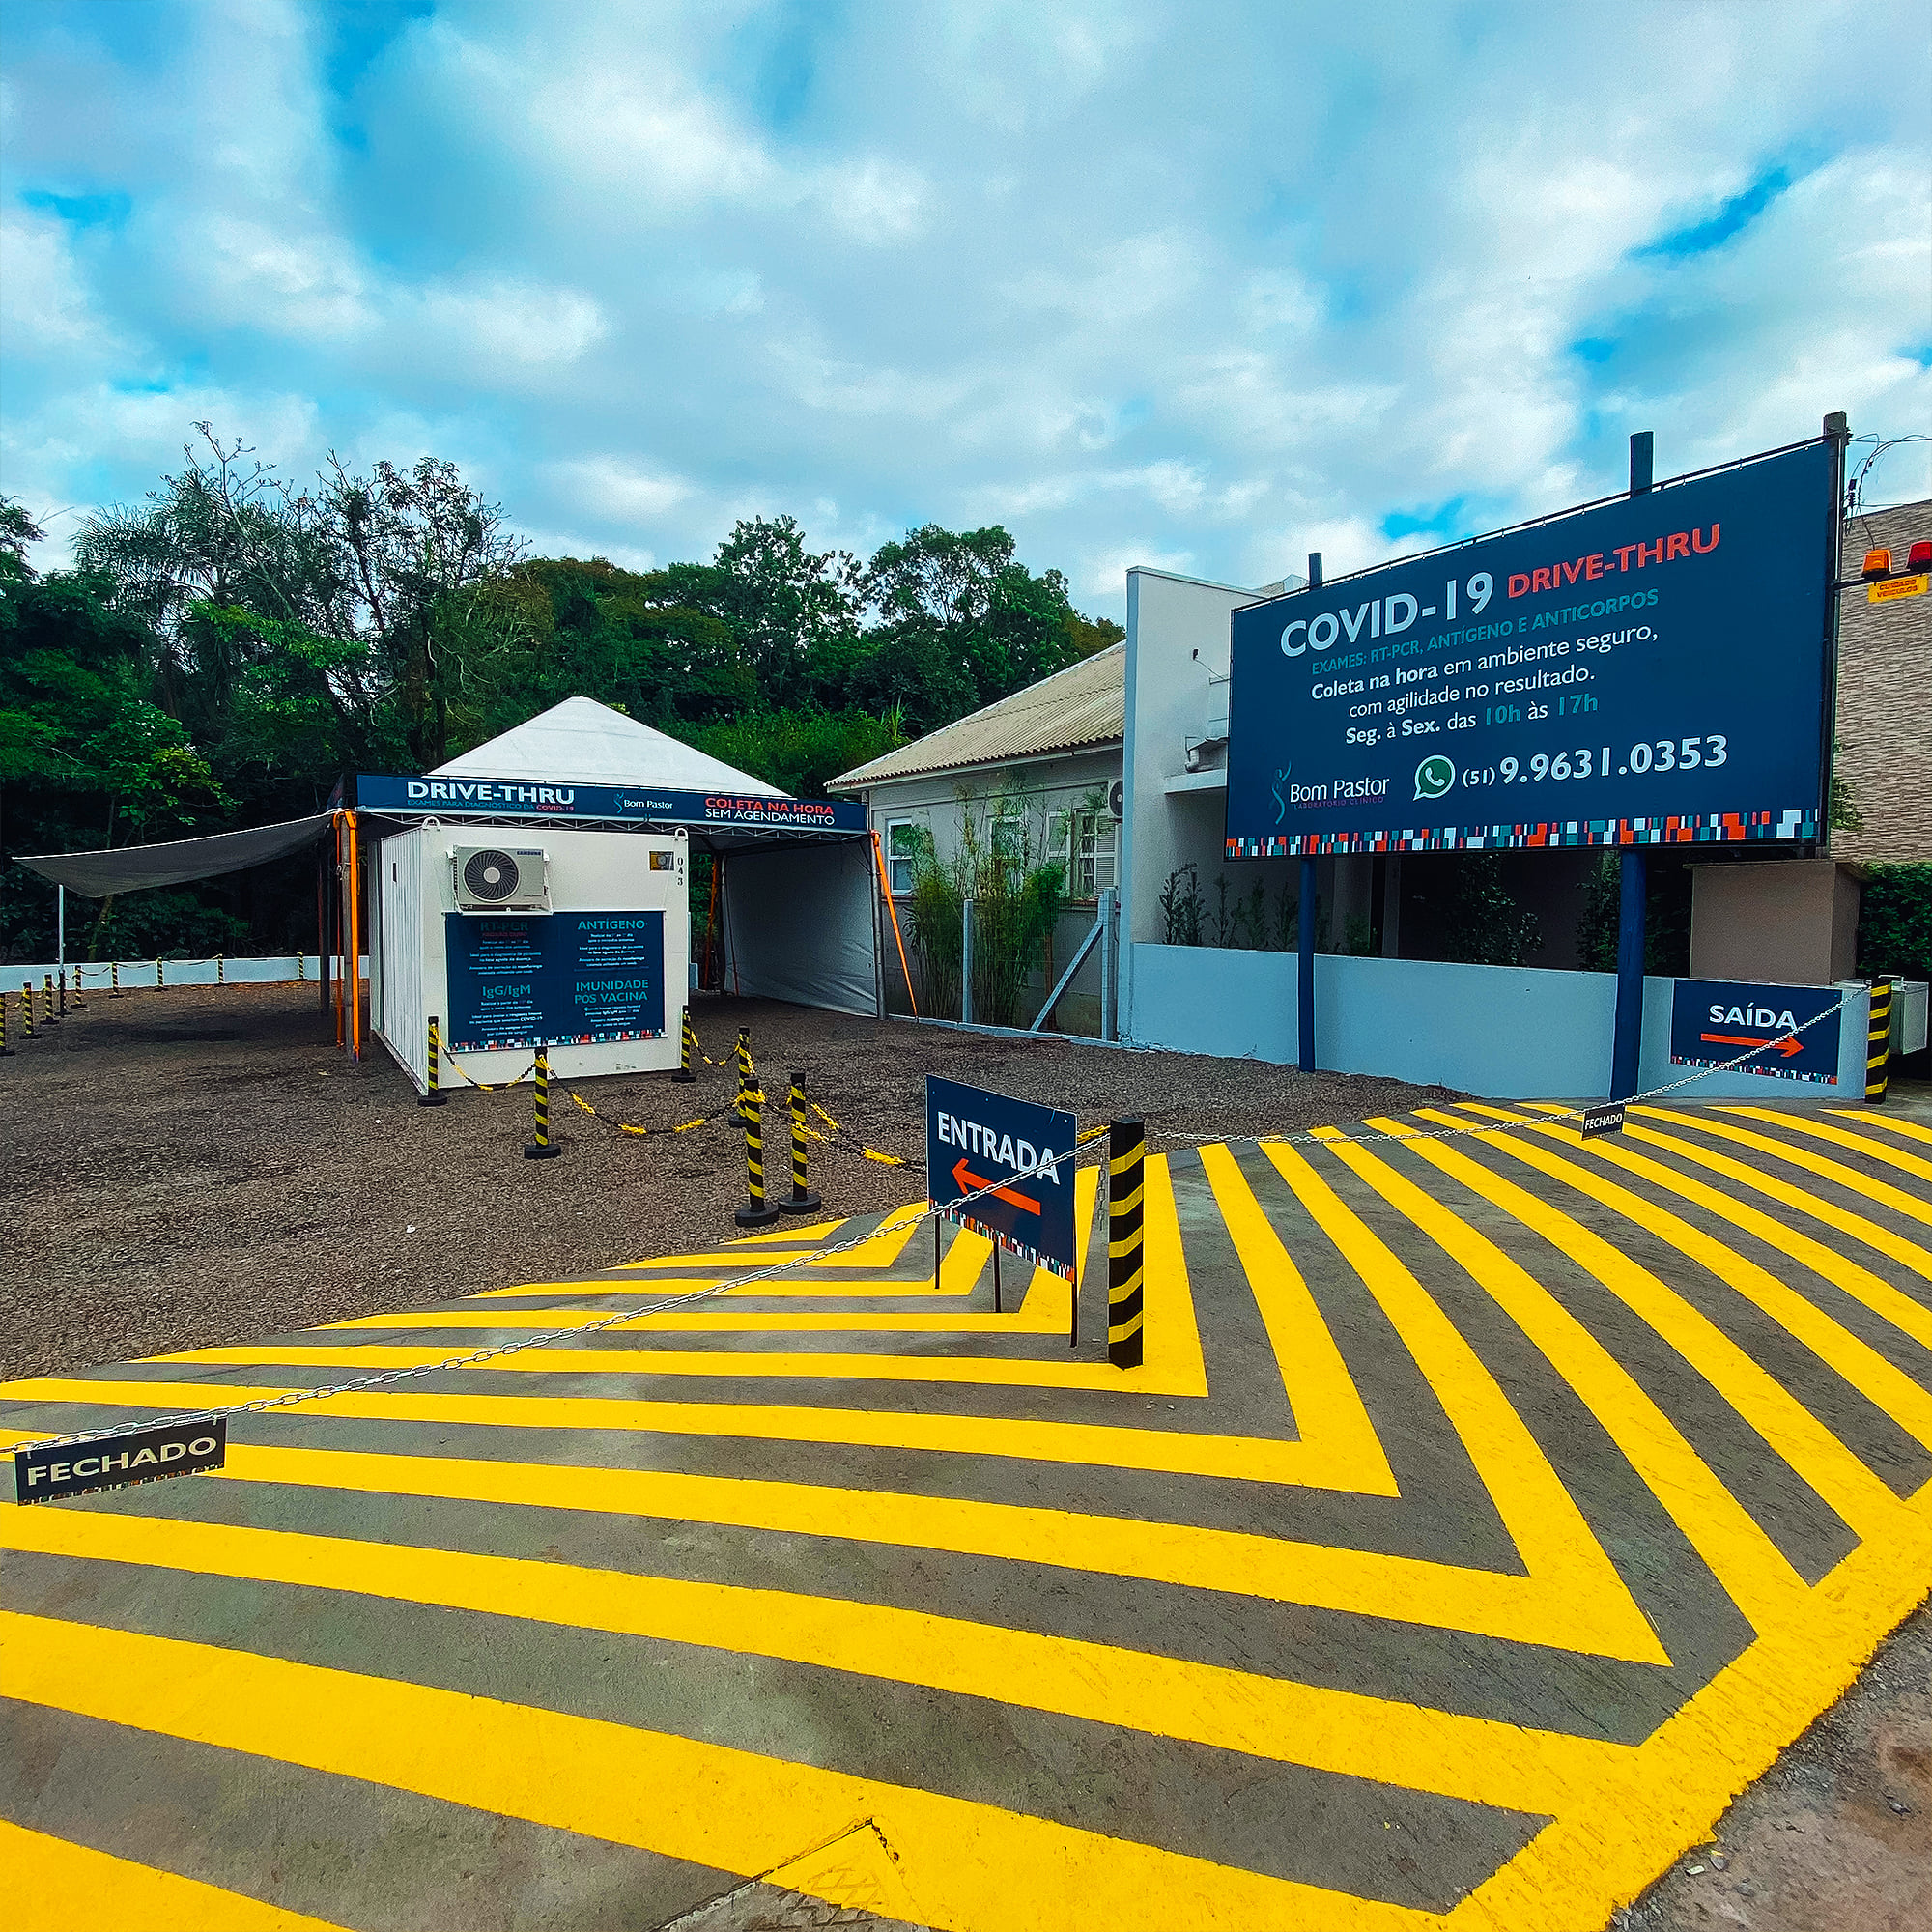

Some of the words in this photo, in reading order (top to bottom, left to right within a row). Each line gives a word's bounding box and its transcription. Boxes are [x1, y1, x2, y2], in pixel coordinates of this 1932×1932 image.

[1280, 571, 1494, 658] COVID-19
[1508, 523, 1721, 599] DRIVE-THRU
[1312, 654, 1368, 675] EXAMES:
[1370, 639, 1423, 664] RT-PCR,
[1427, 620, 1513, 651] ANTÍGENO
[1518, 617, 1527, 633] E
[1532, 588, 1659, 630] ANTICORPOS
[1311, 678, 1364, 700] Coleta
[1369, 674, 1390, 690] na
[1396, 665, 1438, 685] hora
[1444, 661, 1472, 676] em
[1477, 640, 1570, 670] ambiente
[1576, 626, 1659, 653] seguro,
[1350, 701, 1382, 718] com
[1387, 685, 1460, 716] agilidade
[1465, 683, 1490, 699] no
[1495, 665, 1596, 696] resultado.
[1346, 725, 1382, 746] Seg.
[1386, 723, 1397, 739] à
[1401, 717, 1441, 738] Sex.
[1447, 712, 1477, 730] das
[1485, 705, 1521, 726] 10h
[1527, 700, 1548, 721] às
[1558, 693, 1599, 717] 17h
[1462, 766, 1496, 788] (51)
[1499, 734, 1728, 785] 9.9631.0353
[407, 781, 575, 804] DRIVE-THRU
[1290, 783, 1327, 803] Bom
[1333, 777, 1390, 799] Pastor
[624, 799, 645, 809] Bom
[647, 800, 673, 810] Pastor
[705, 797, 763, 810] COLETA
[768, 800, 789, 812] NA
[793, 803, 834, 815] HORA
[705, 808, 731, 818] SEM
[734, 810, 835, 825] AGENDAMENTO
[578, 917, 645, 930] ANTÍGENO
[483, 984, 531, 999] IgG/IgM
[576, 979, 649, 992] IMUNIDADE
[600, 990, 648, 1003] VACINA
[1709, 1002, 1797, 1030] SAÍDA
[1584, 1112, 1623, 1130] FECHADO
[937, 1111, 1060, 1185] ENTRADA
[27, 1436, 217, 1487] FECHADO
